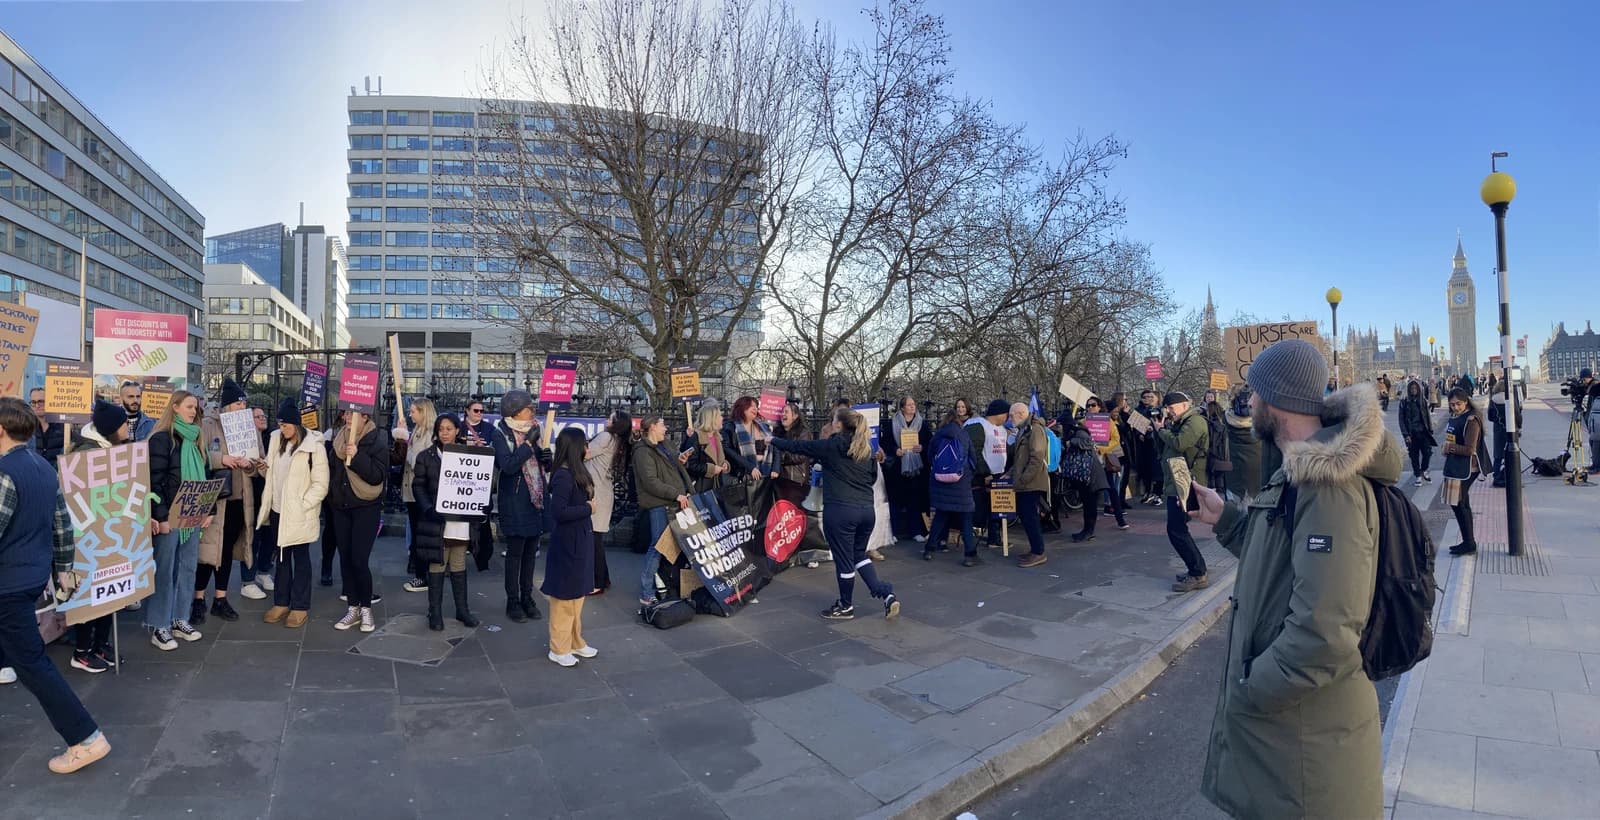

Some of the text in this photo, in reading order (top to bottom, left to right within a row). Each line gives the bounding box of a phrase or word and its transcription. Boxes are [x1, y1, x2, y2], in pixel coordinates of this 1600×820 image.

[127, 320, 159, 328] DISCOUNTS
[1237, 324, 1314, 344] NURSES ARE
[114, 344, 145, 368] STAR
[138, 347, 168, 372] CARD
[344, 380, 374, 390] shortages
[60, 440, 148, 494] KEEP
[459, 458, 480, 466] YOU
[444, 470, 472, 480] GAVE
[179, 480, 223, 492] PATIENTS
[457, 487, 473, 496] NO
[176, 494, 199, 505] ARE
[65, 482, 161, 538] URSES
[180, 505, 198, 516] WE
[442, 500, 485, 511] CHOICE
[94, 562, 132, 580] IMPROVE
[96, 580, 132, 599] PAY!
[712, 582, 726, 593] Fair
